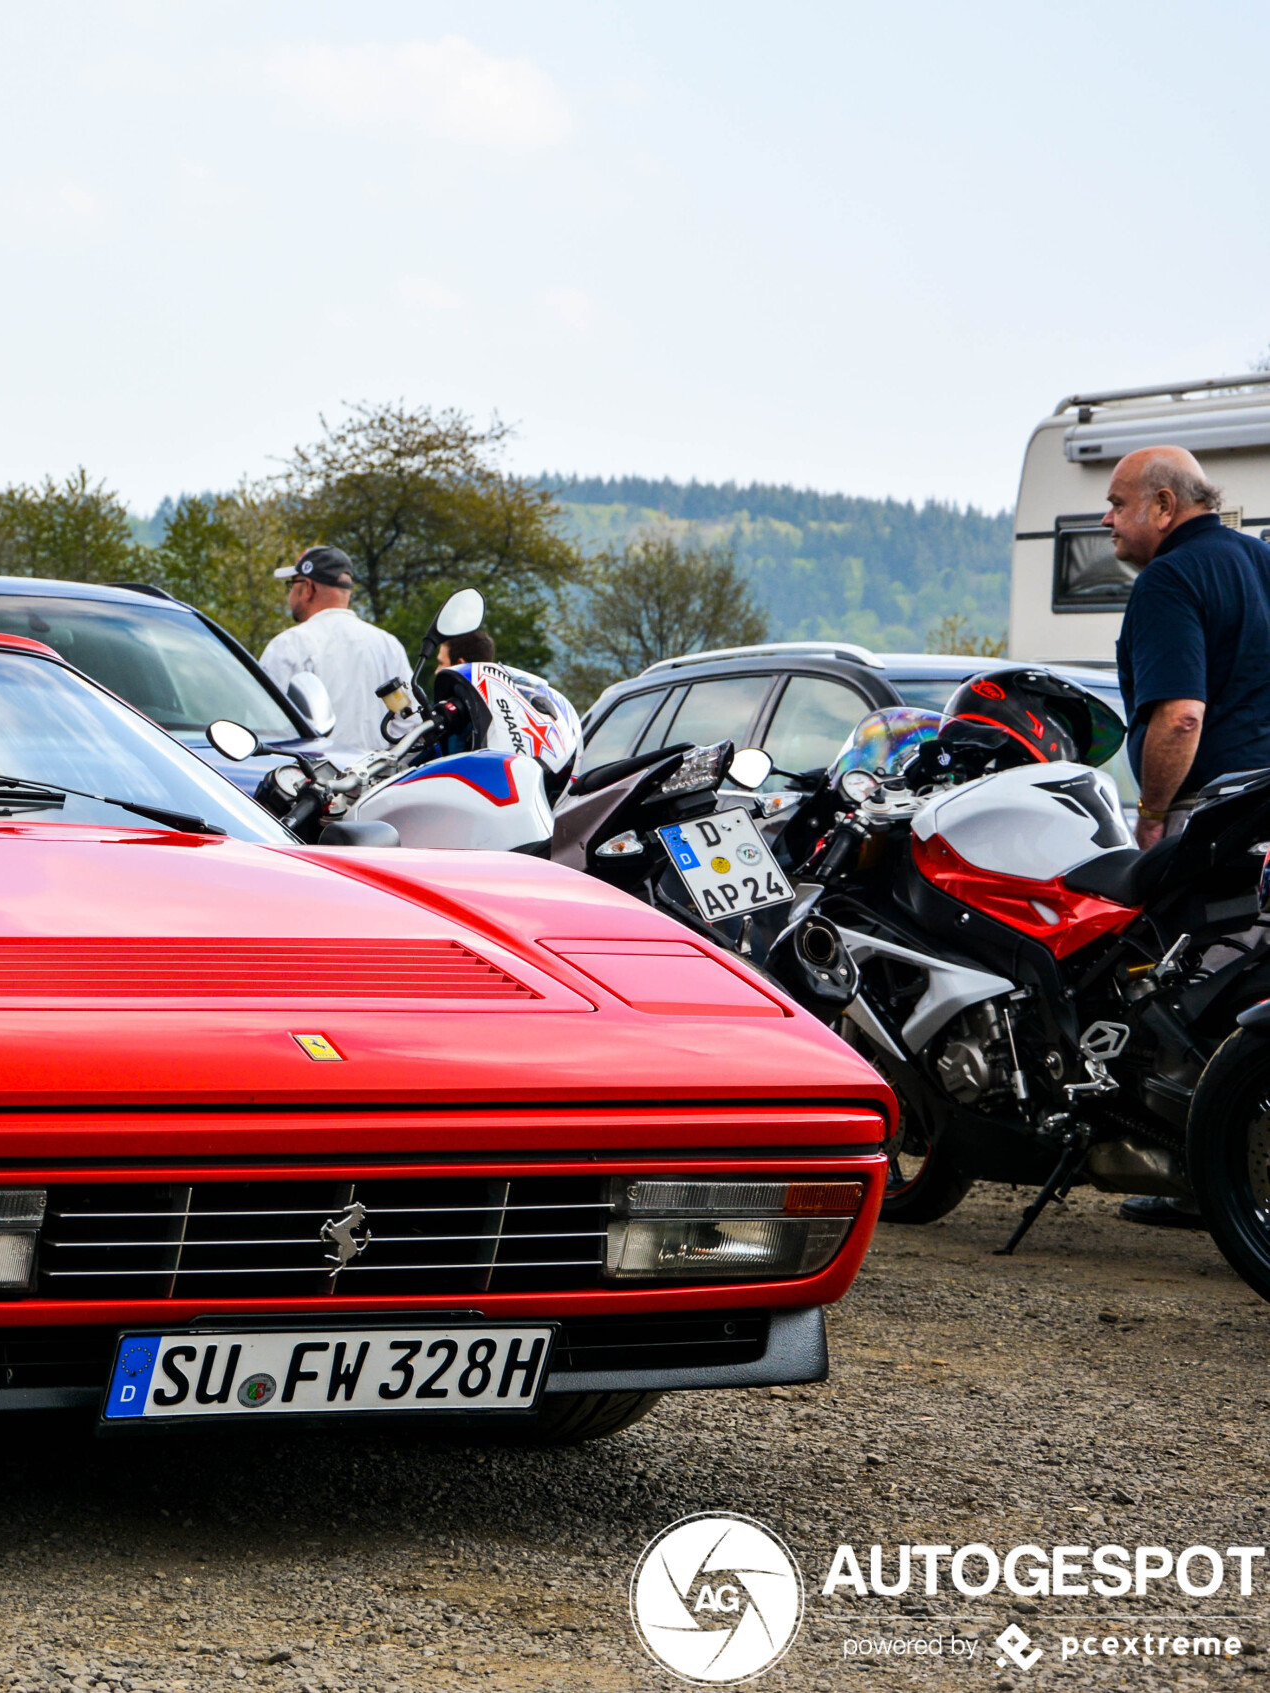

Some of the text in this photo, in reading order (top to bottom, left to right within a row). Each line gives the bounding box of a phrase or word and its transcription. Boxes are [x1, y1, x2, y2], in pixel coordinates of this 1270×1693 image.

[496, 699, 527, 755] SHARK
[696, 821, 722, 848] D
[679, 853, 692, 865] D
[703, 871, 784, 915] AP 24
[153, 1345, 242, 1406] SU
[281, 1341, 370, 1402] FW
[378, 1337, 545, 1400] 328H
[120, 1385, 136, 1402] D
